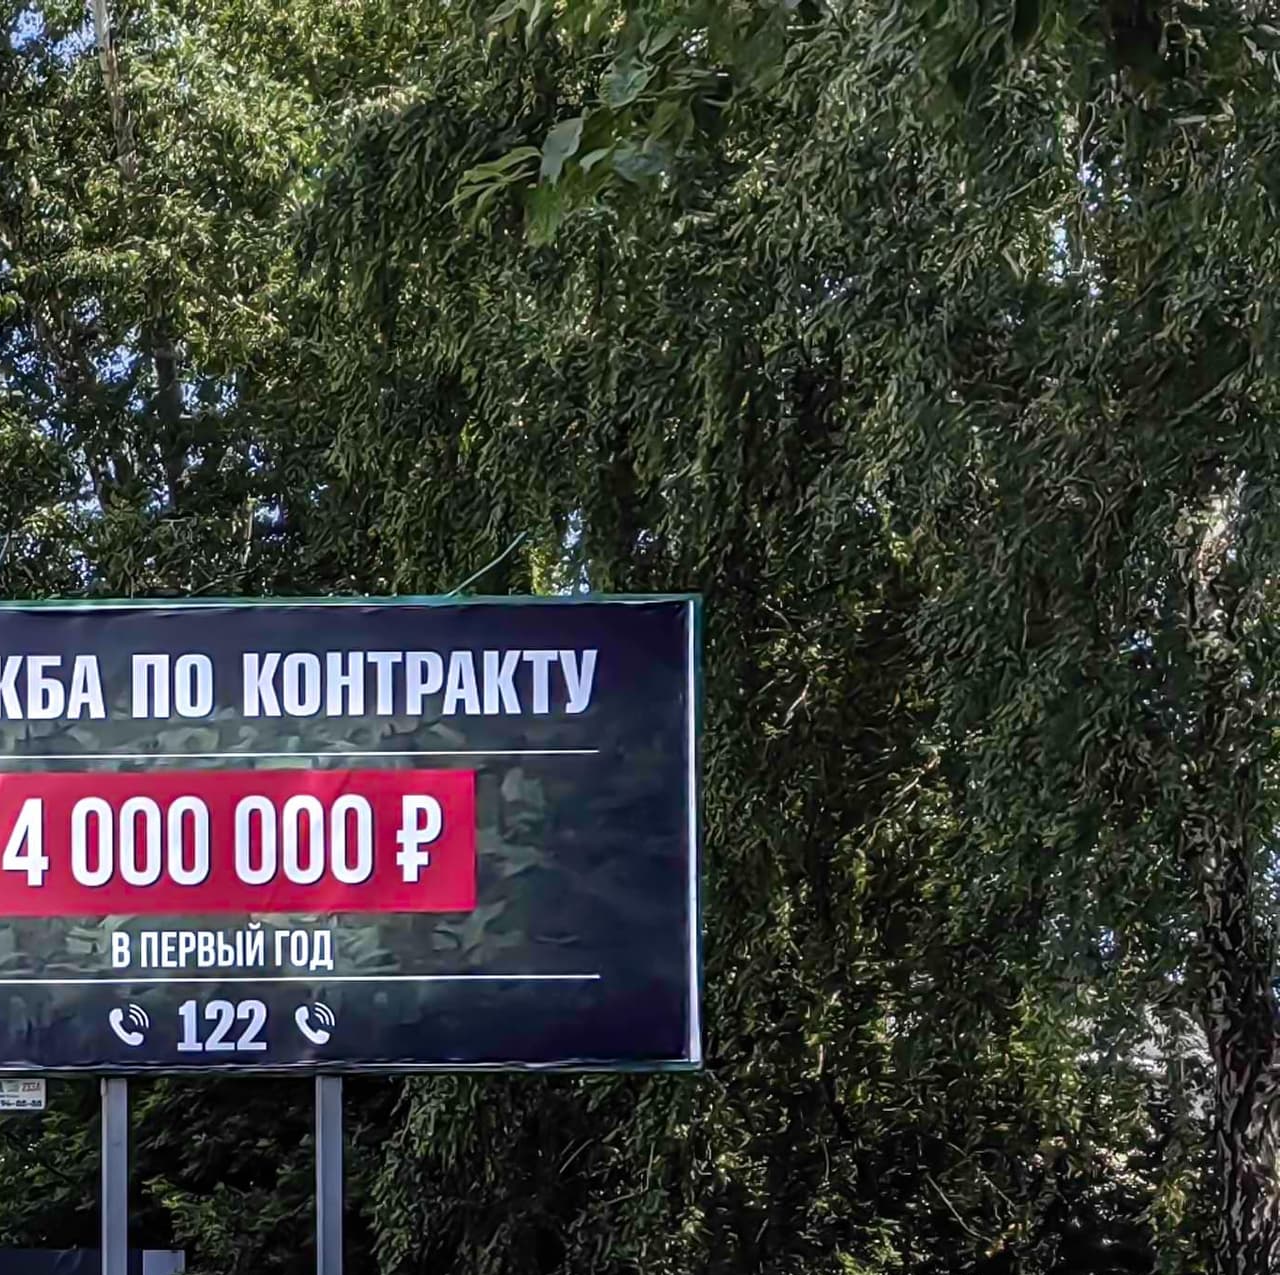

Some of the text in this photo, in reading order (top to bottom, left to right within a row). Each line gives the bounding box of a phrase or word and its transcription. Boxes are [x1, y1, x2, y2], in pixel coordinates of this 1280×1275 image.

[131, 653, 214, 719] ПО
[242, 649, 599, 718] КОНТРАКТУ
[1, 797, 50, 887] 4
[70, 796, 211, 888] 000
[234, 794, 374, 886] 000
[395, 794, 443, 883] ₽
[111, 921, 335, 972] В ПЕРВЫЙ ГОД
[176, 999, 268, 1052] 122
